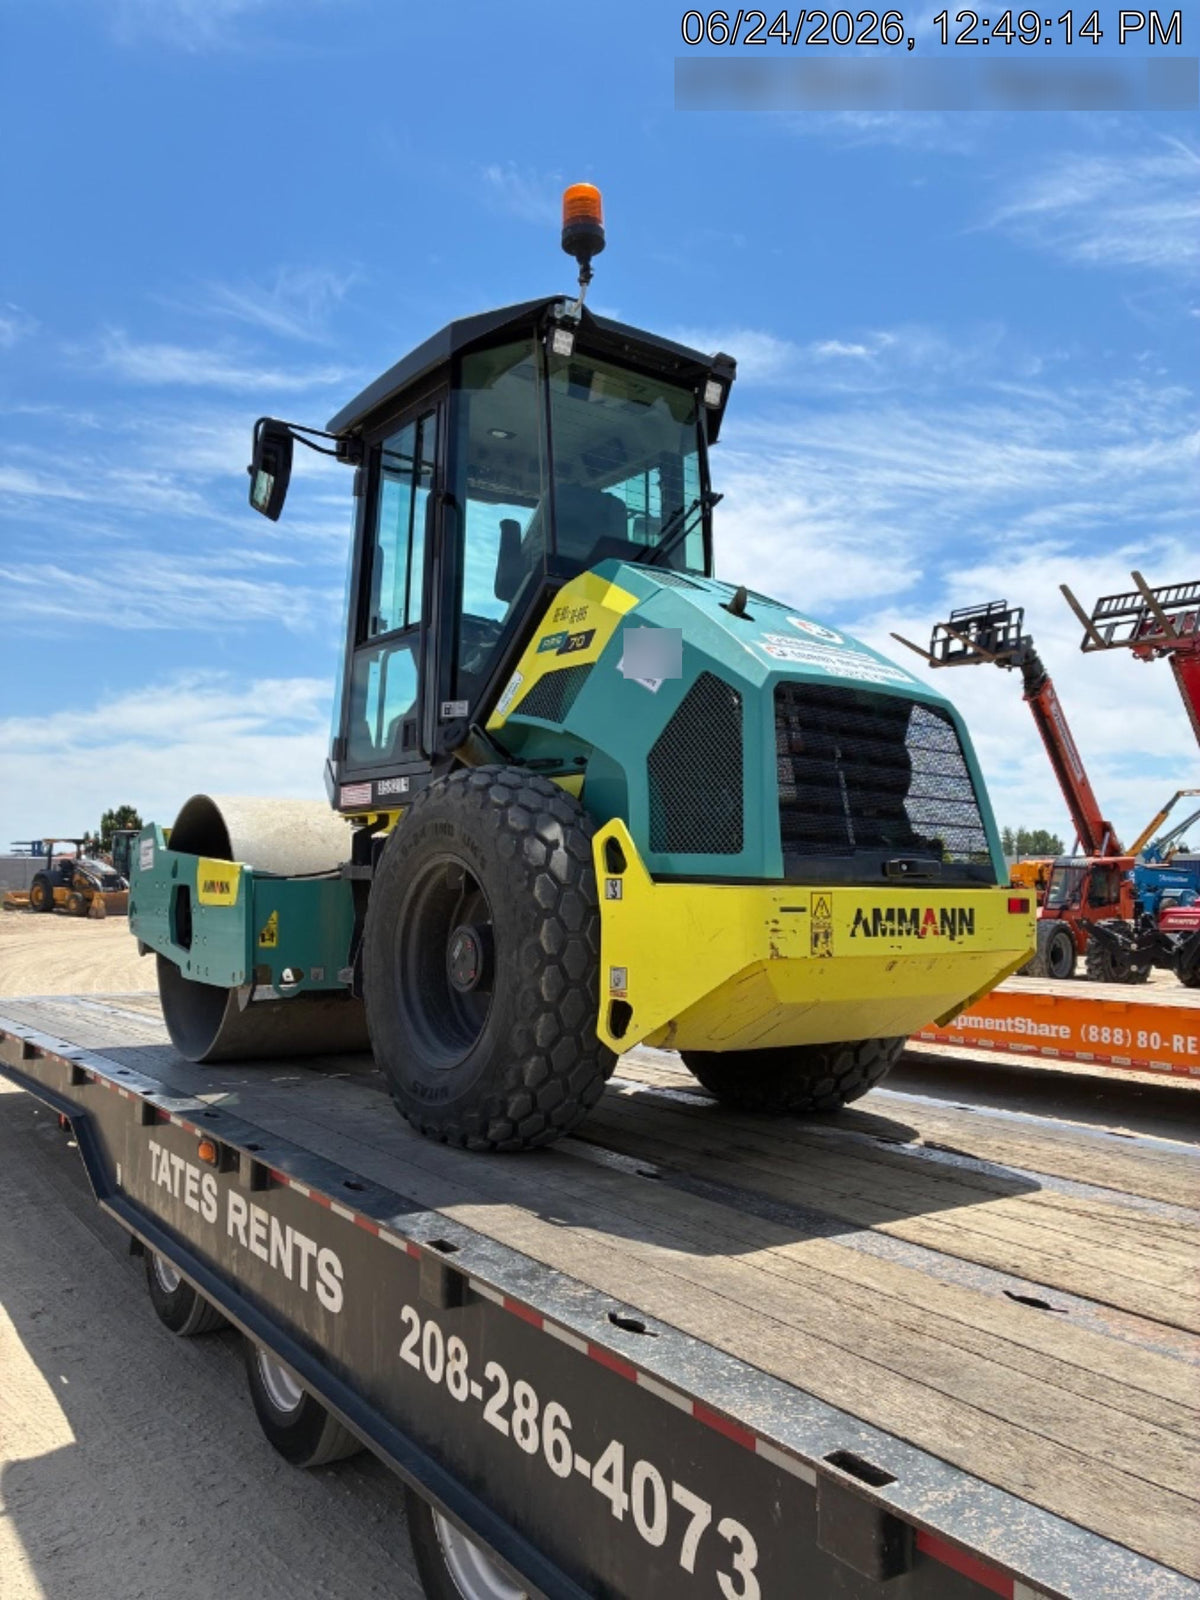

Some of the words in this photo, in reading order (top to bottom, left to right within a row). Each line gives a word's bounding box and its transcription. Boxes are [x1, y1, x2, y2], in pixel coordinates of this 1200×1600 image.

[849, 907, 975, 939] AMMANN
[1081, 1023, 1132, 1048] (888)
[148, 1139, 218, 1225] TATES
[226, 1189, 344, 1314] RENTS
[399, 1304, 761, 1600] 208-286-4073
